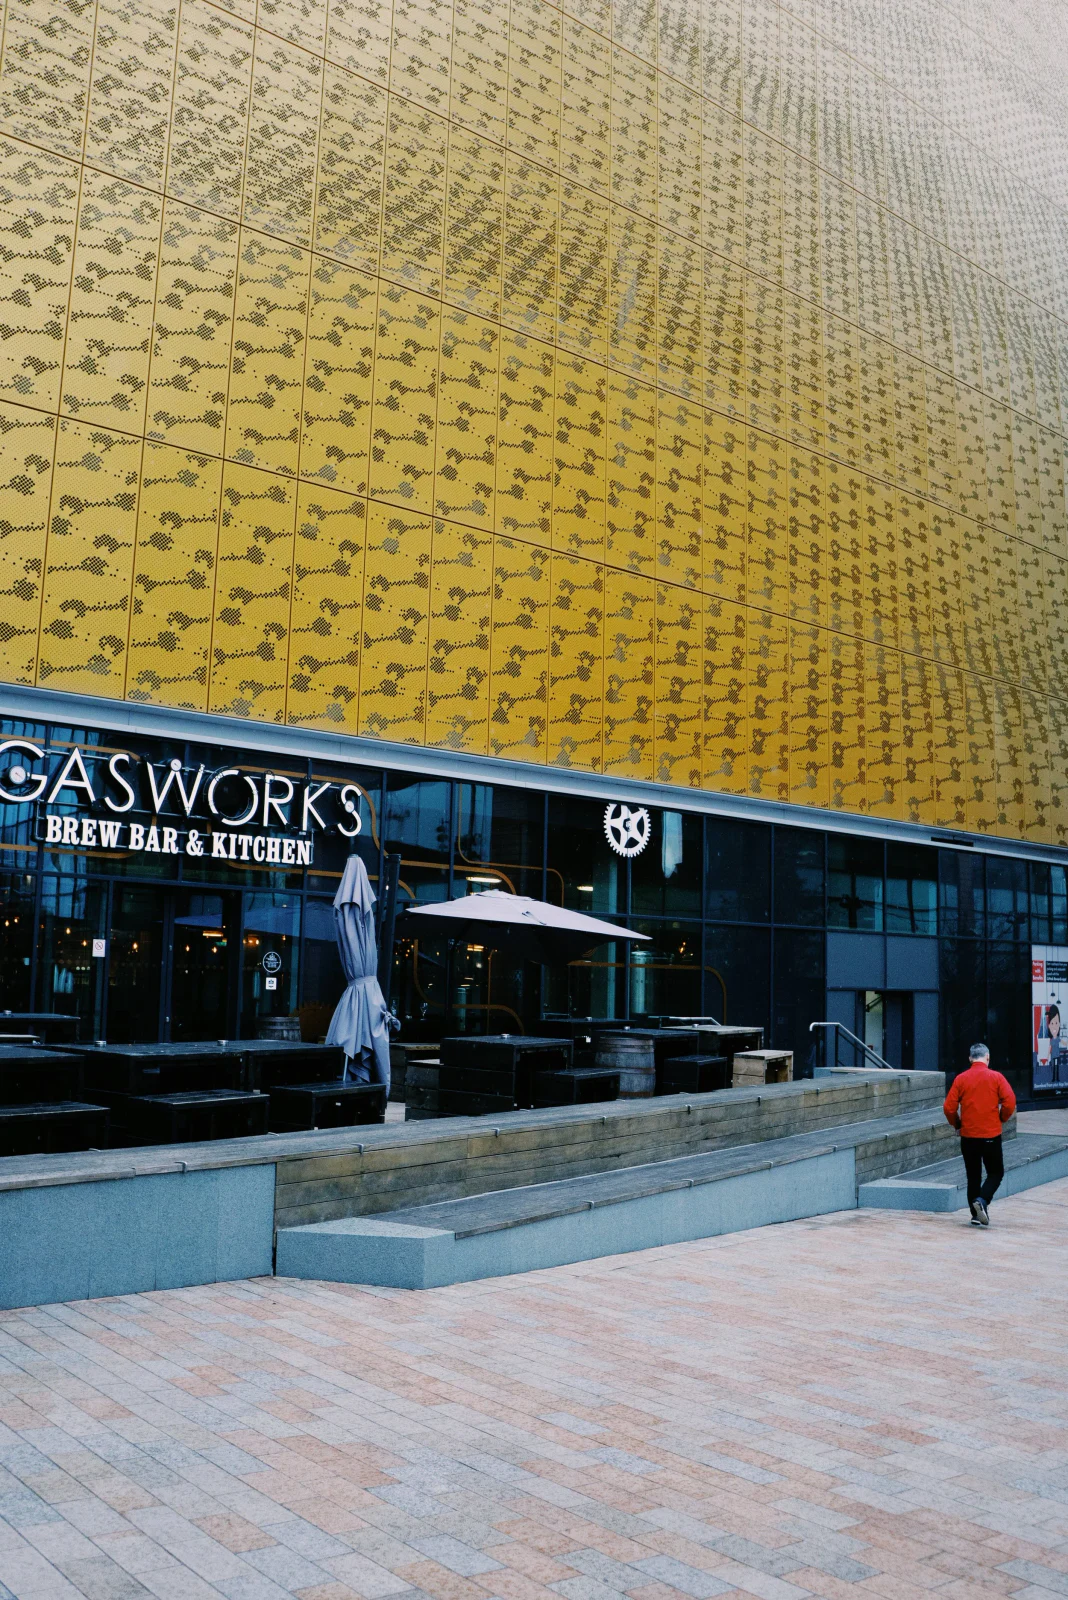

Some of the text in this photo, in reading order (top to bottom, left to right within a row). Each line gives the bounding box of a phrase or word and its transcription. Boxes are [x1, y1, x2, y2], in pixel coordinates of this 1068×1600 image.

[0, 739, 362, 838] GASWORKS
[45, 814, 313, 866] BREW BAR & KITCHEN
